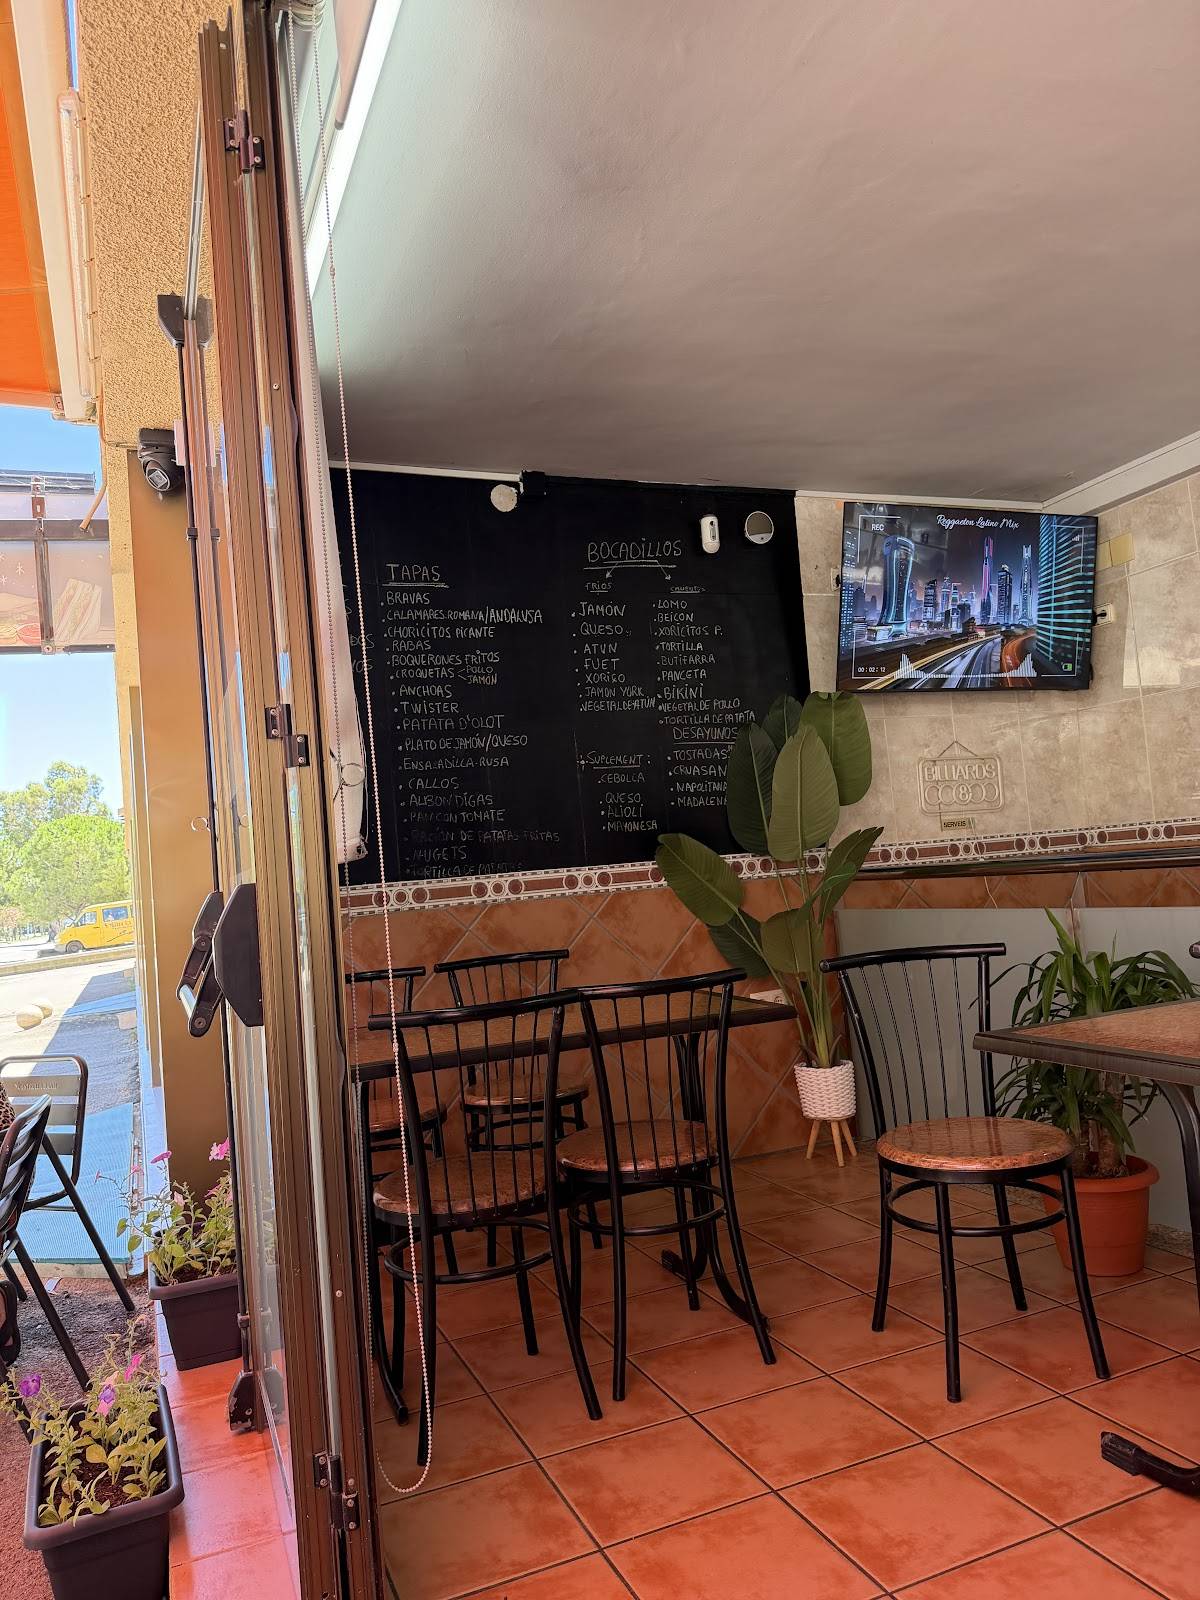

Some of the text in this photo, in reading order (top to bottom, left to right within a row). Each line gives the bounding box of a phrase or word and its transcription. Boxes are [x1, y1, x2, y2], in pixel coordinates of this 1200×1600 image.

[871, 523, 885, 531] REC
[937, 514, 1020, 530] Reggaeton Latino Mix
[587, 537, 682, 562] BOCADILLOS
[385, 562, 441, 582] TAPAS
[386, 591, 431, 605] BRAVAS
[657, 600, 688, 609] LOMO
[386, 609, 445, 621] CALAMARES
[657, 611, 694, 623] BEICON
[387, 622, 497, 638] CHORICITOS PICANTE
[580, 621, 623, 636] QUESO
[658, 622, 710, 637] XORICITOS
[392, 640, 432, 652] RABAS
[583, 641, 618, 655] ATUN
[659, 640, 704, 652] TORTILLA
[391, 653, 463, 667] BOQUERONES
[464, 649, 500, 665] FRITOS
[583, 657, 620, 671] FUET
[660, 653, 716, 666] BUTIFARRA
[395, 667, 456, 679] CROQUETAS
[465, 666, 494, 674] POLLO
[661, 668, 708, 681] PANCETA
[399, 684, 453, 699] ANCHOAS
[619, 685, 645, 698] YORK
[663, 682, 704, 699] BIKINI
[399, 700, 460, 715] TWISTER
[581, 700, 623, 712] VEGETAL
[660, 700, 699, 712] VEGETAL
[713, 698, 741, 710] POLLO
[402, 714, 505, 731] PATATA D'OLOT
[664, 710, 756, 725] TORTILLA DE PATATA
[672, 726, 739, 740] DESAYUNOS
[404, 737, 437, 752] PLATO
[438, 737, 454, 750] DE
[673, 764, 728, 777] CRUASAN
[924, 763, 996, 782] BILLIARDS
[407, 776, 460, 790] CALLOS
[599, 772, 646, 784] CEBOLLA
[605, 792, 642, 804] QUESO
[959, 784, 969, 801] 8
[459, 808, 506, 824] TOMATE
[607, 803, 643, 818] ALIOLI
[607, 820, 658, 832] MAYONESA
[943, 820, 967, 828] SERVEIS
[460, 830, 475, 842] DE
